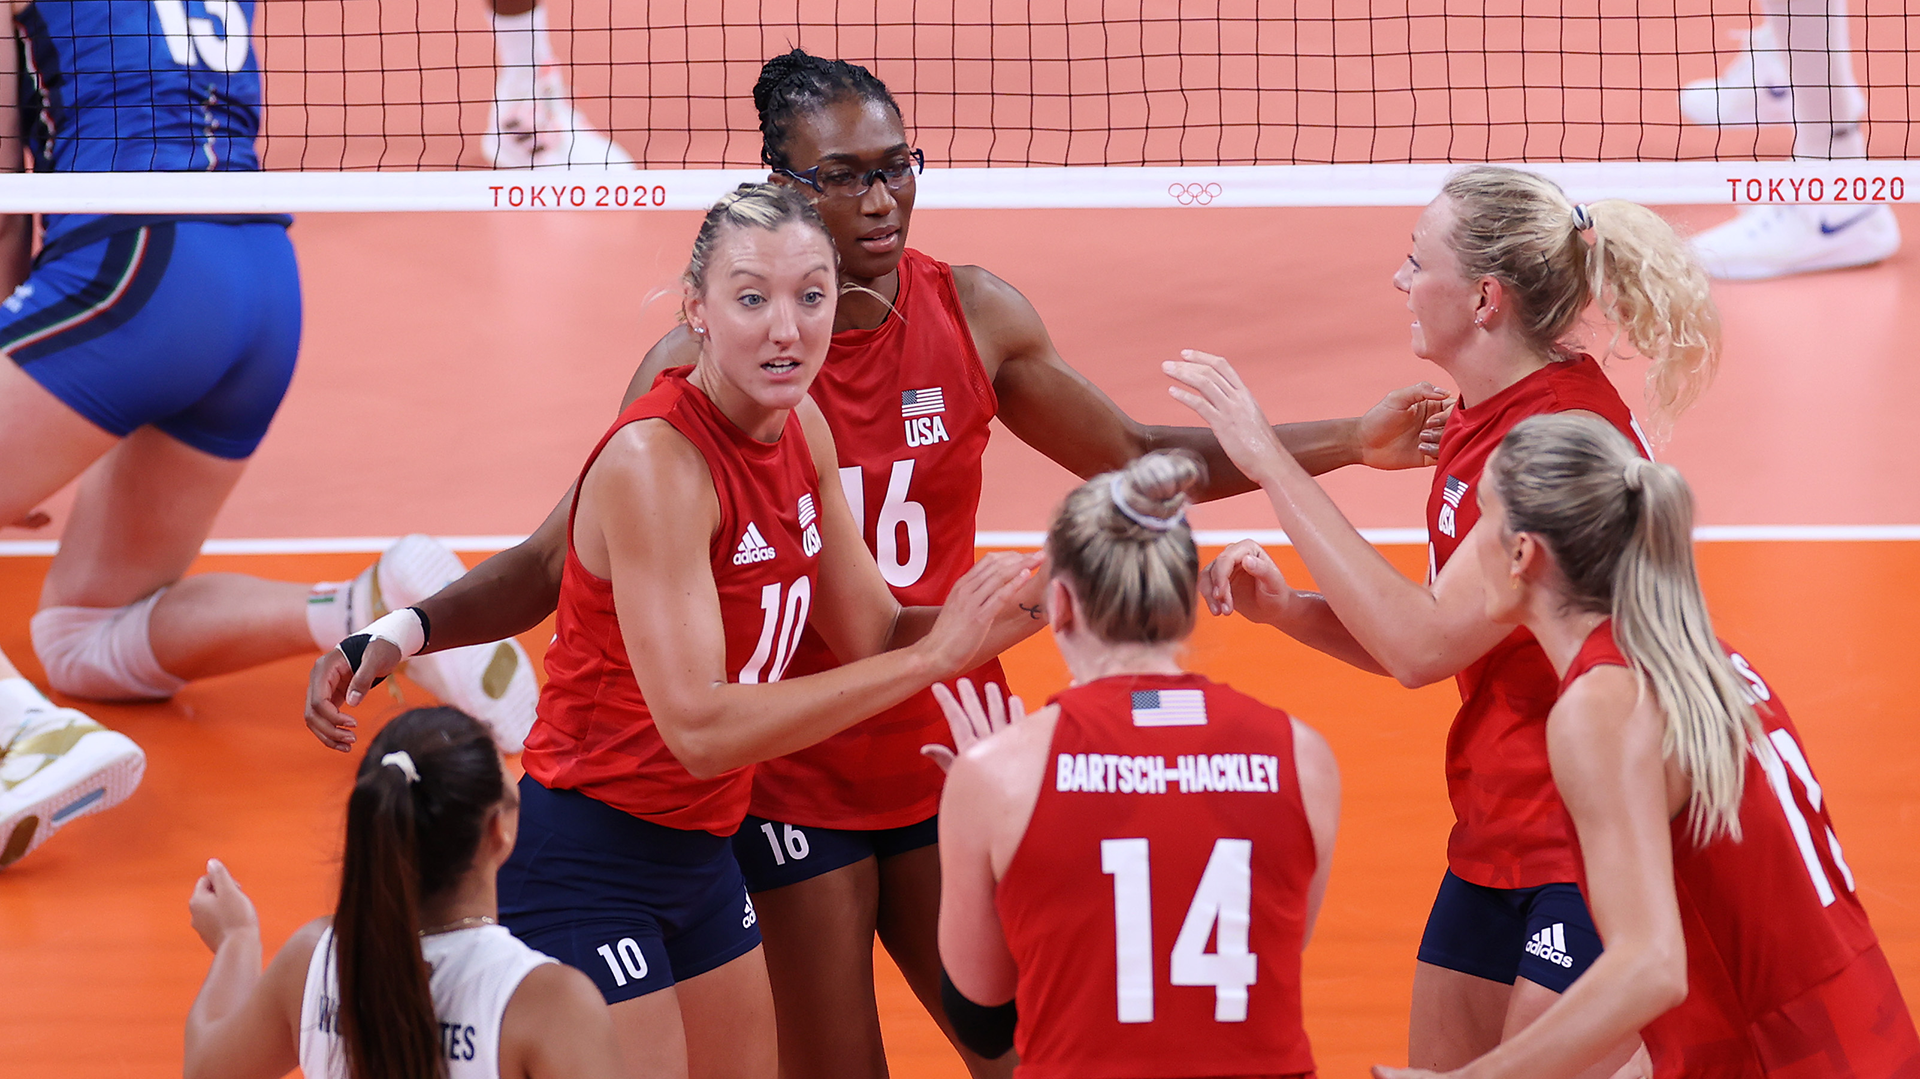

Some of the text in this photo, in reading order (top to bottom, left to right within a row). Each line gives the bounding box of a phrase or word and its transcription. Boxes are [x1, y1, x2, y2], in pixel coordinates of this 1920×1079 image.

[488, 184, 667, 208] TOKYO 2020
[1726, 176, 1905, 202] TOKYO 2020
[904, 415, 950, 448] USA
[1438, 502, 1456, 539] USA
[732, 546, 777, 566] adidas
[803, 522, 823, 558] USA
[738, 575, 812, 686] 10
[1056, 752, 1280, 795] BARTSCH-HACKLEY
[760, 822, 810, 866] 16
[1100, 837, 1258, 1024] 14
[596, 937, 649, 987] 10
[1525, 940, 1574, 969] adidas
